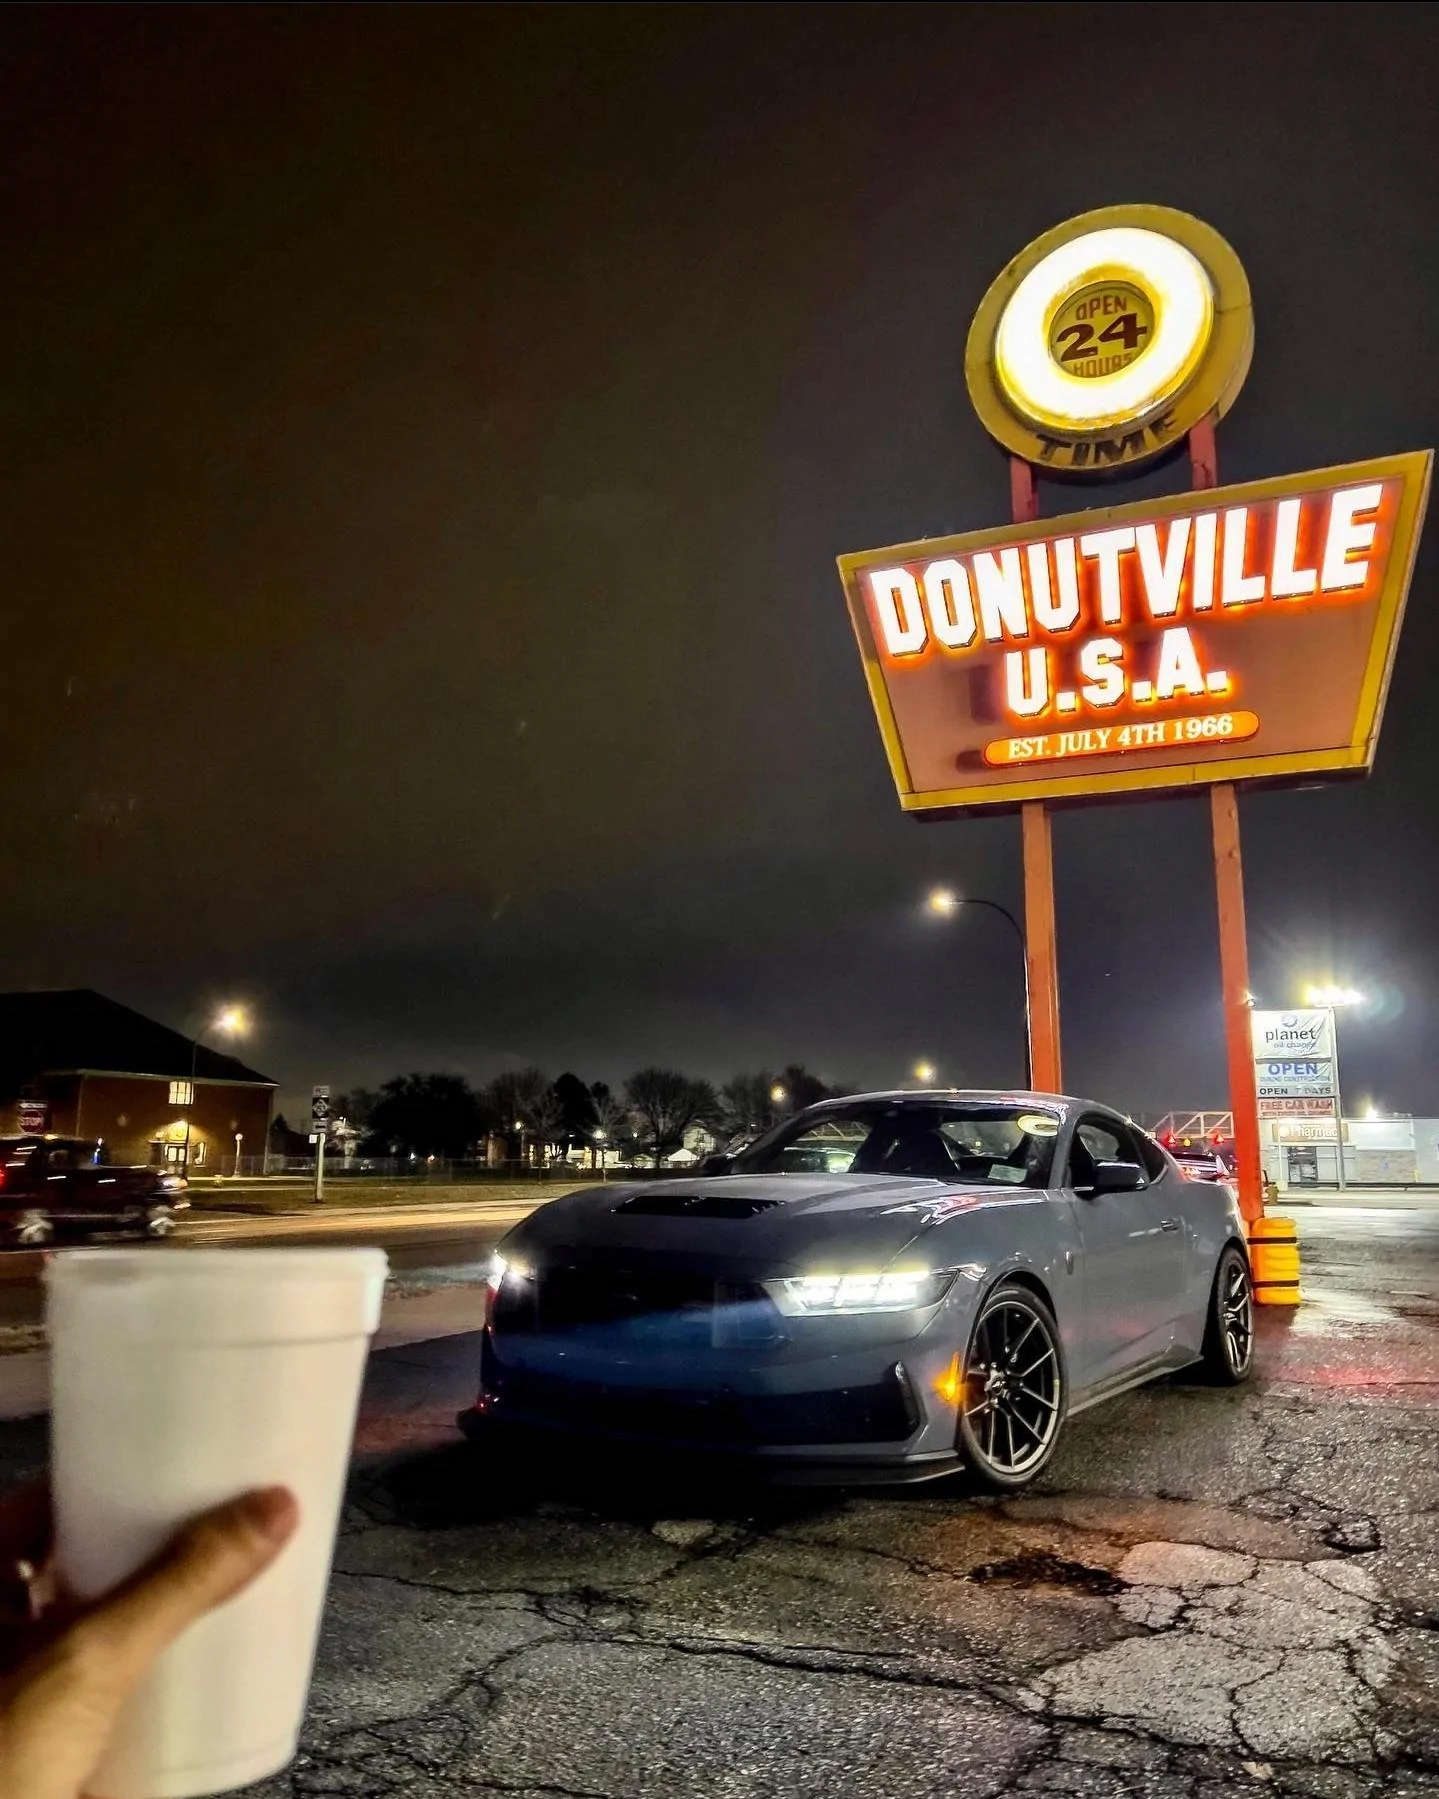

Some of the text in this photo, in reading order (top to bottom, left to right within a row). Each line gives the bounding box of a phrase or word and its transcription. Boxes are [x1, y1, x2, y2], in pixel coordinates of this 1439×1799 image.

[1075, 295, 1127, 321] OPEN
[1055, 313, 1148, 362] 24
[1071, 353, 1136, 378] HOURS
[1034, 408, 1178, 467] TIME
[869, 483, 1385, 657] DONUTVILLE
[1005, 627, 1229, 718] U.S.A.
[1008, 714, 1232, 760] EST. JULY 4TH 1966
[1265, 1027, 1316, 1043] planet
[1268, 1062, 1318, 1075] OPEN
[1259, 1087, 1288, 1095] OPEN
[1304, 1087, 1331, 1095] DAYS
[1260, 1098, 1333, 1110] FREE CAR WASH
[20, 1117, 41, 1126] STOP
